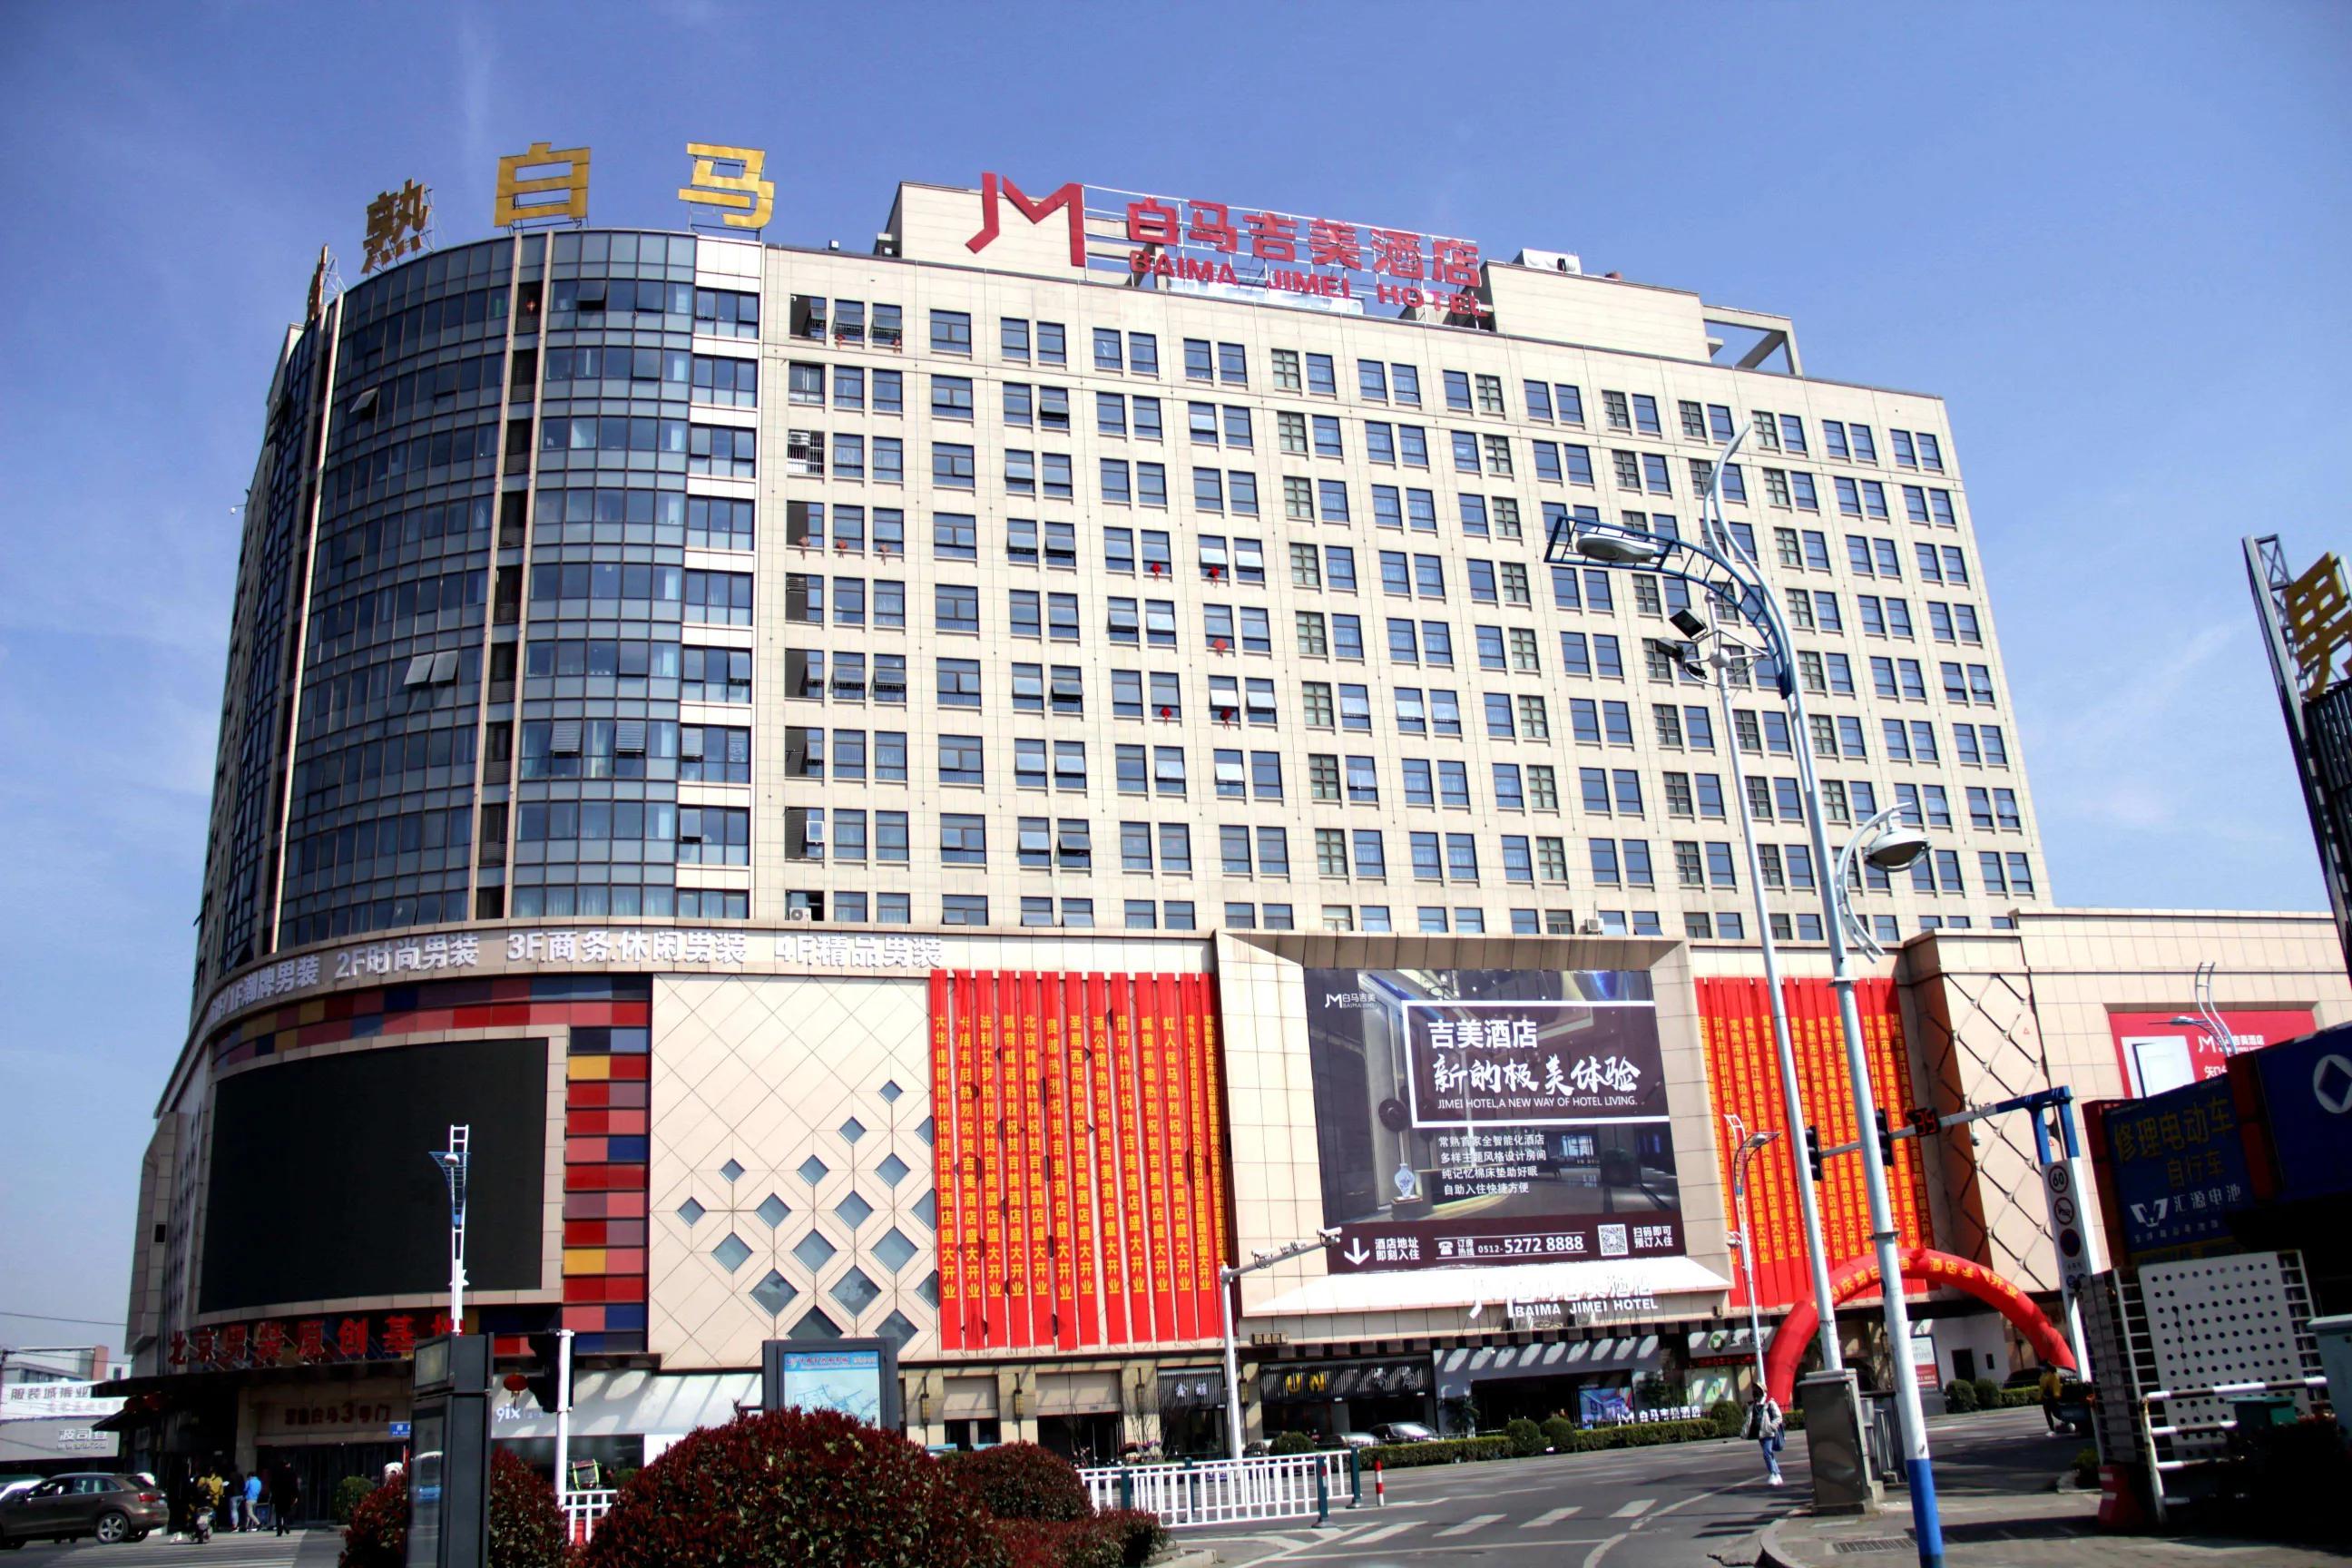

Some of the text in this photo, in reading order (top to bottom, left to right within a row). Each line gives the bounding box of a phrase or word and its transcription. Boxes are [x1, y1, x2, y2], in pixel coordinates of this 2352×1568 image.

[1127, 196, 1483, 289] 白马吉美酒店
[1129, 250, 1490, 318] BAIMA JIMEI HOTEL
[334, 933, 480, 980] 2F时尚男装
[506, 930, 746, 965] 3F商务休闲男装
[774, 934, 943, 969] 4F精品男装
[1342, 993, 1377, 1003] 白马吉美
[1427, 1018, 1538, 1050] 吉美酒店
[1433, 1053, 1641, 1096] 新的极美体验
[1437, 1099, 1463, 1110] JIMEI
[1508, 1098, 1532, 1109] NEW
[1534, 1098, 1554, 1108] WAY
[1556, 1097, 1570, 1107] OF
[1573, 1096, 1603, 1107] HOTEL
[2113, 1095, 2235, 1164] 修理电动车
[1438, 1133, 1545, 1148] 常熟首家全智能化酒店
[1440, 1150, 1547, 1164] 多样主题风格设计房间
[1442, 1165, 1539, 1180] 纯记忆棉床垫助好眠
[2166, 1150, 2225, 1188] 自行车
[1444, 1181, 1530, 1196] 自助入住快捷方便
[2173, 1183, 2242, 1213] 汇源电池
[1632, 1225, 1672, 1238] 扫码即可
[1375, 1238, 1419, 1250] 酒店地址
[1545, 1236, 1584, 1252] 8888
[1633, 1236, 1674, 1249] 预订入住
[1376, 1250, 1421, 1261] 即刻入住
[1514, 1298, 1659, 1318] BAIMA JIMEI HOTEL
